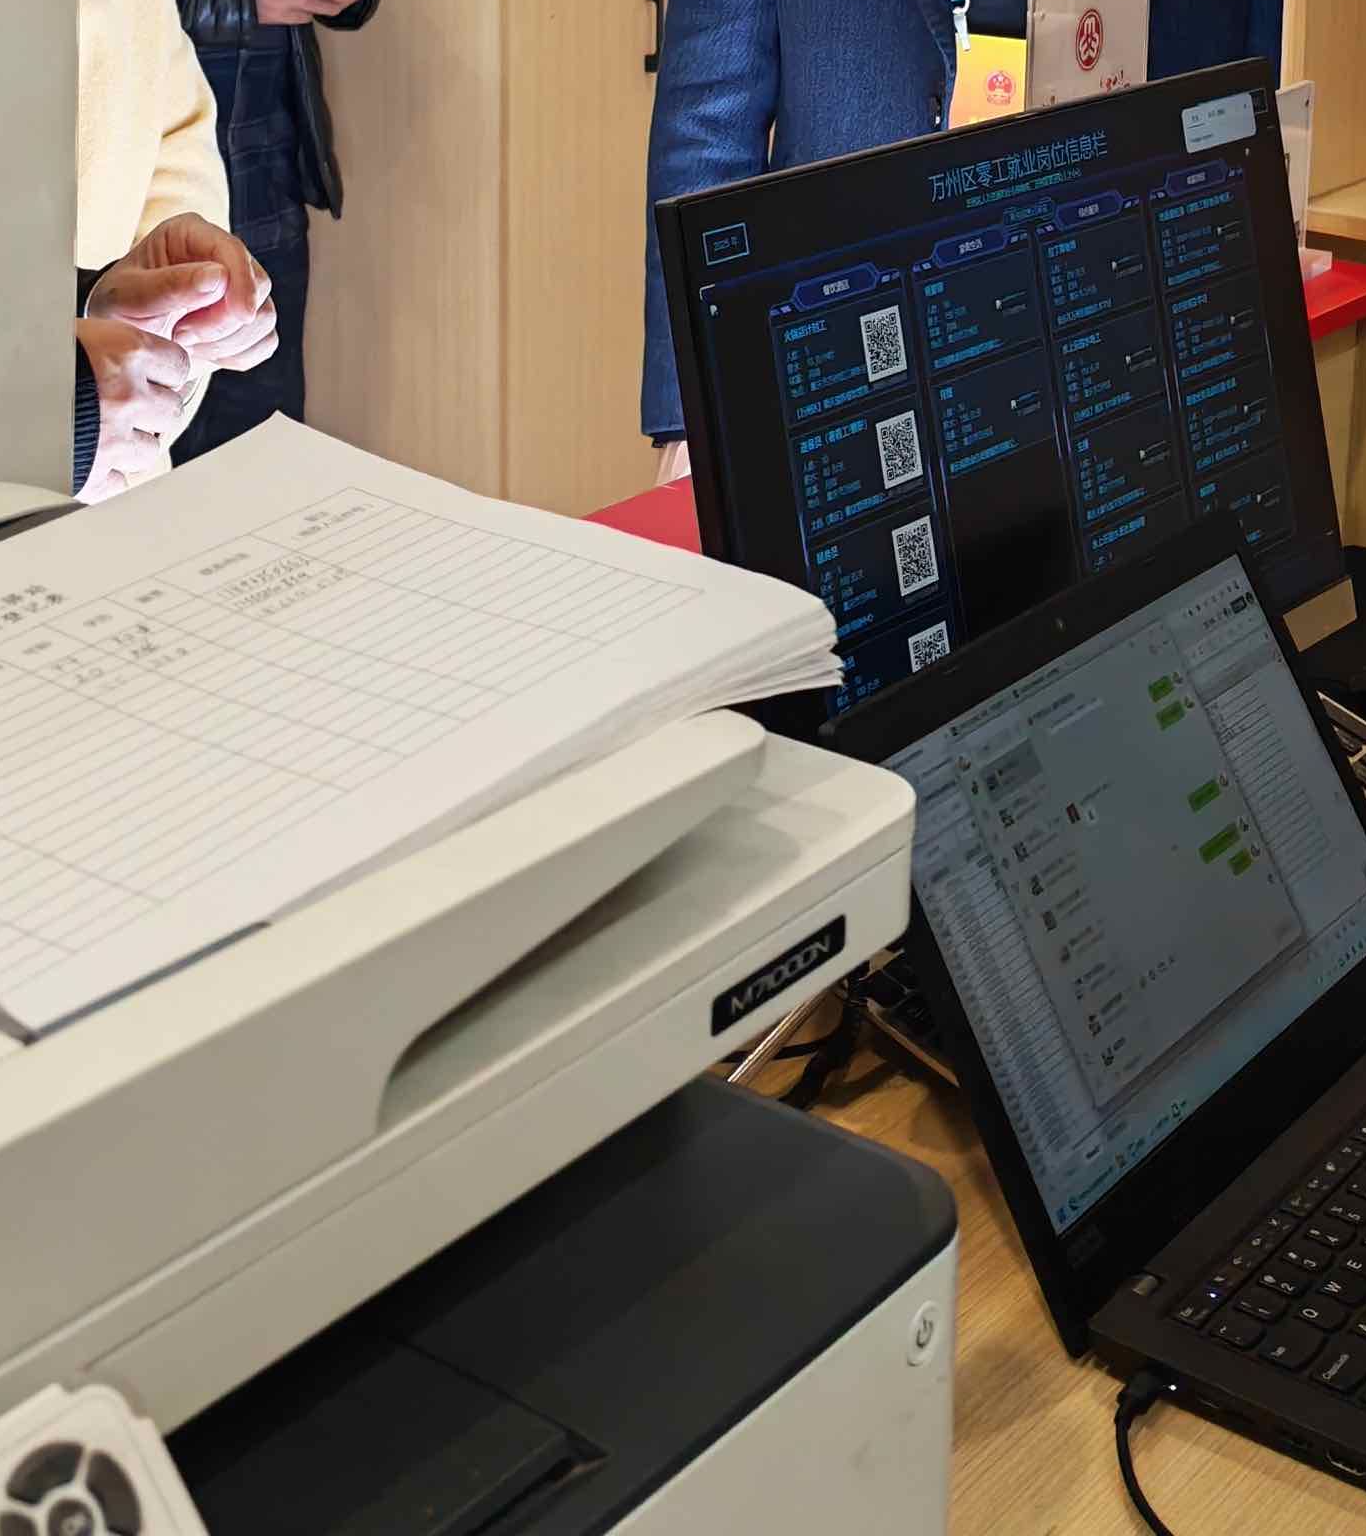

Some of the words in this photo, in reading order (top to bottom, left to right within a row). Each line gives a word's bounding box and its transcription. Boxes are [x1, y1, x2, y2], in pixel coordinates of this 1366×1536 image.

[929, 129, 1108, 204] 万州区零工就业岗位信息栏
